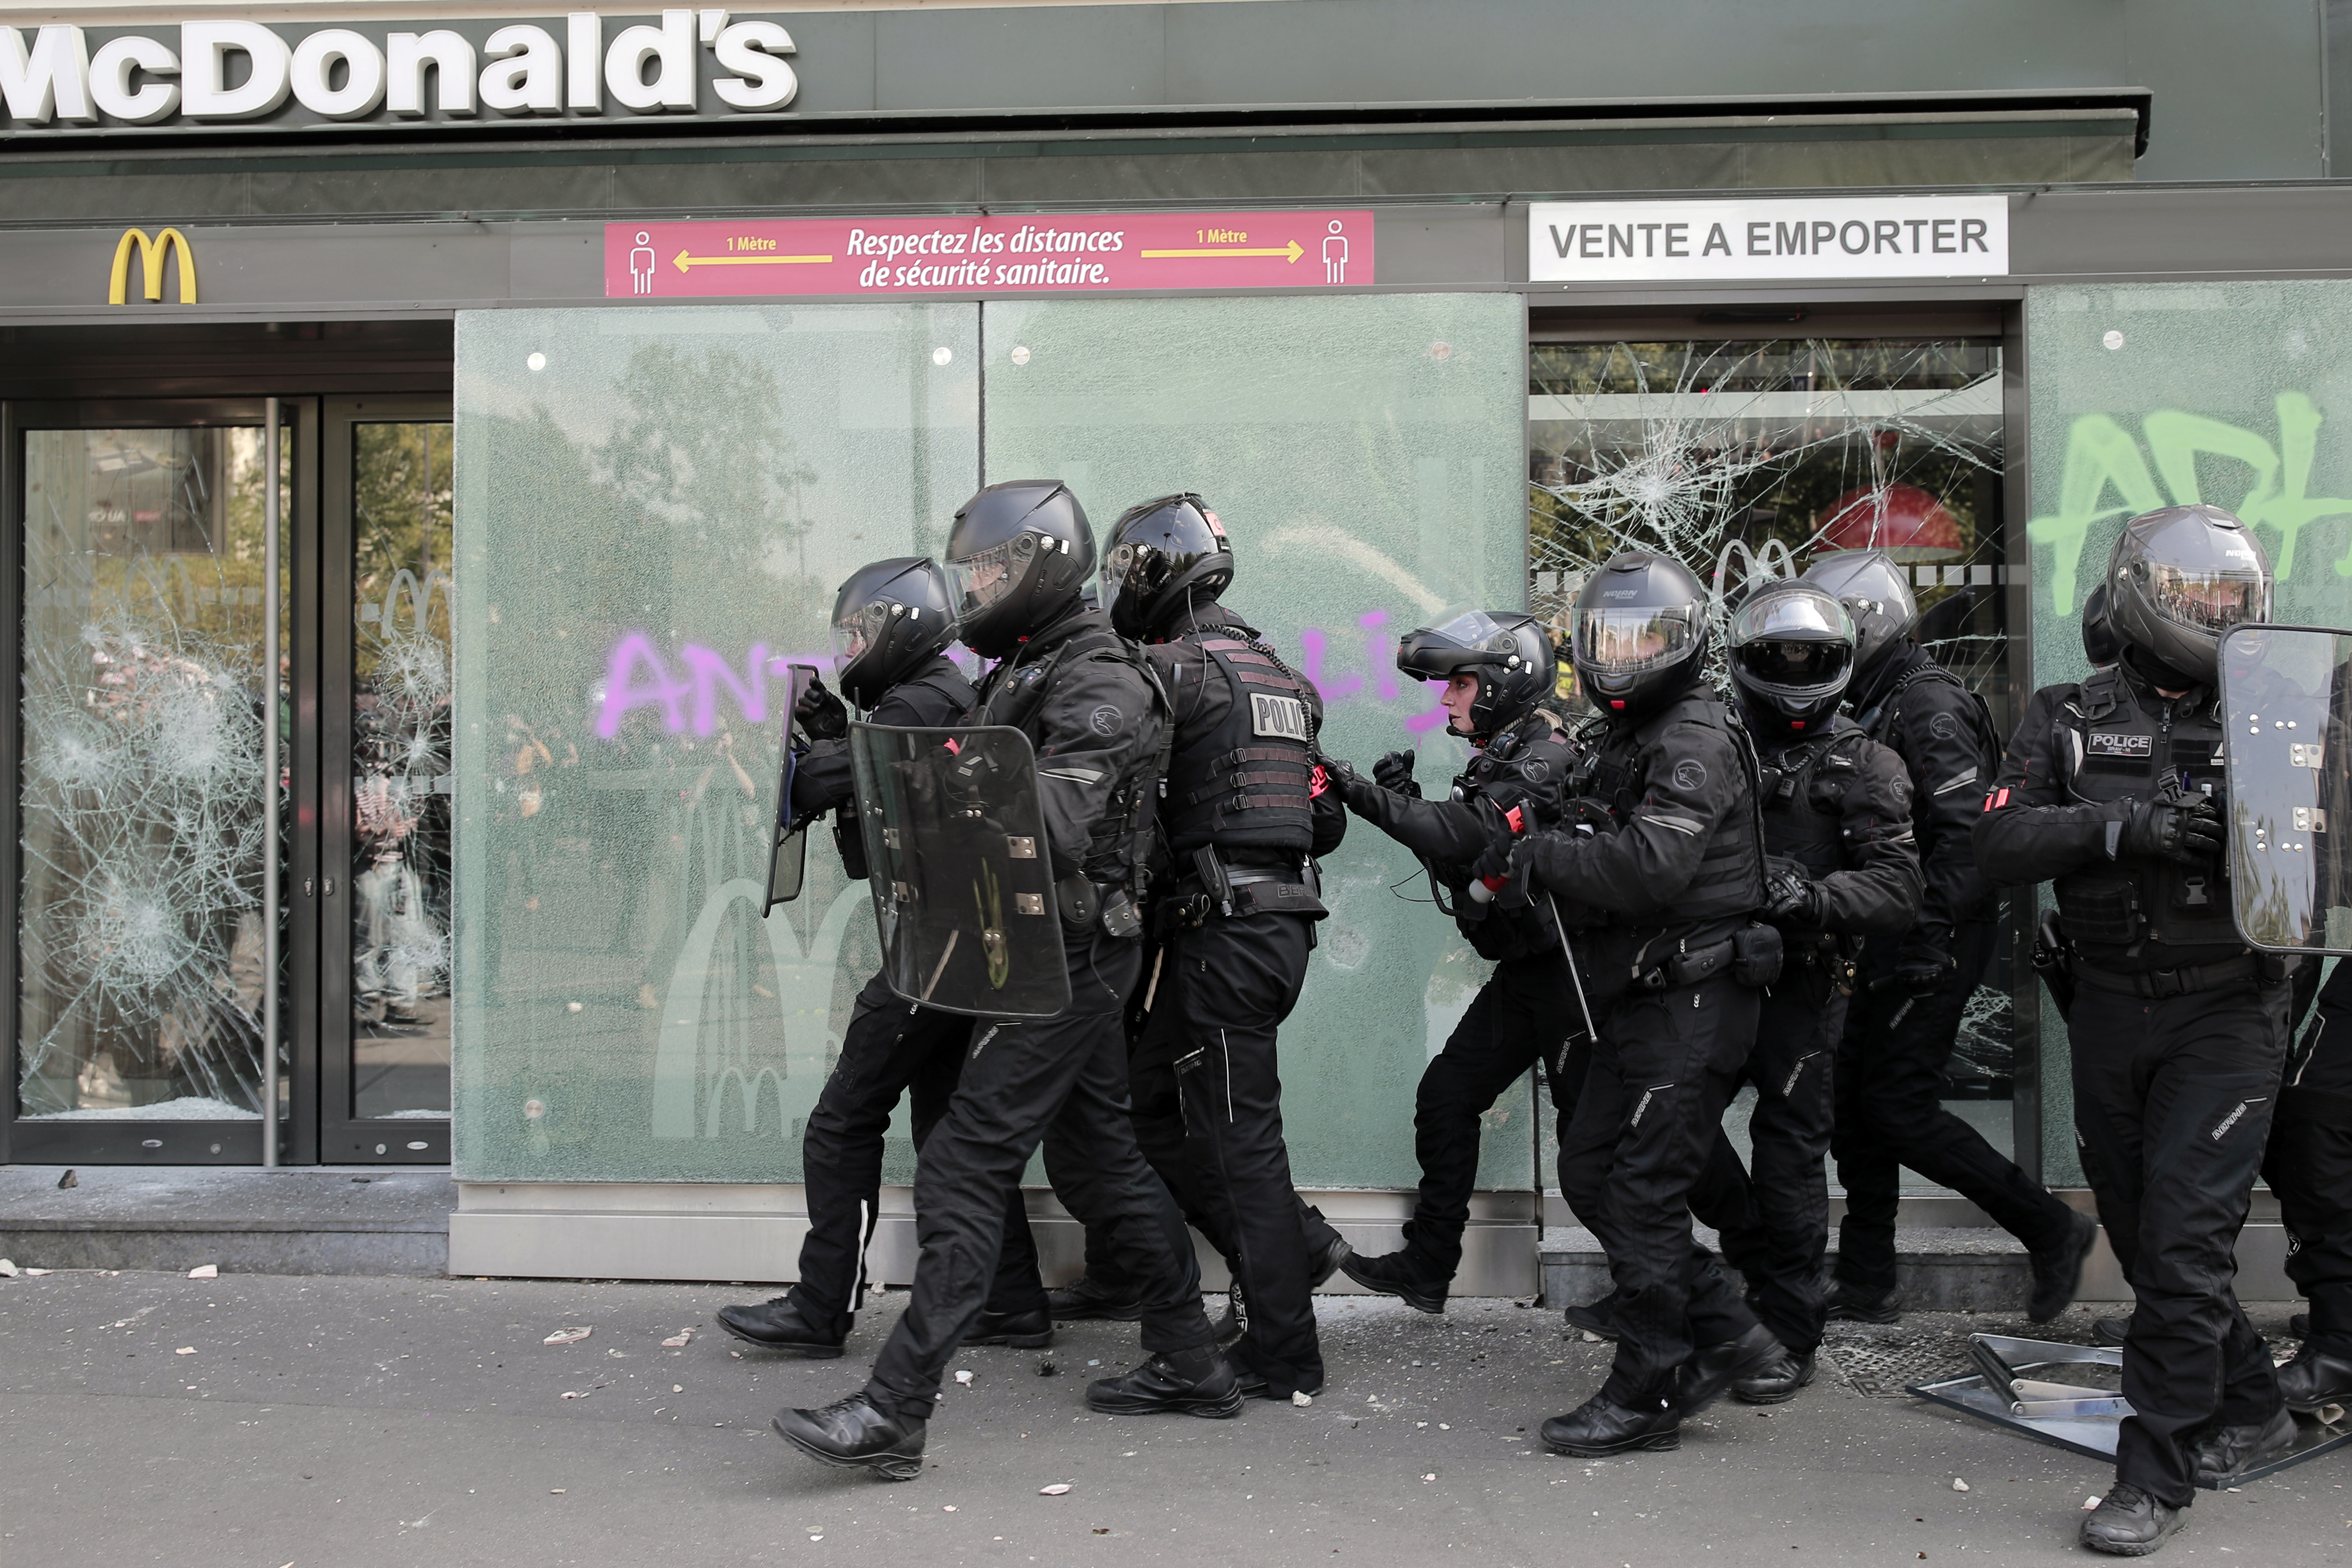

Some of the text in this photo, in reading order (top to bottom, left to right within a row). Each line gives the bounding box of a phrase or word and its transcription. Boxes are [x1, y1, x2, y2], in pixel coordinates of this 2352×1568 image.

[0, 8, 797, 123] McDonald's
[727, 236, 777, 251] 1 Mètre
[846, 224, 1124, 262] Respectez les distances
[1197, 228, 1248, 243] 1 Mètre
[1549, 218, 1989, 258] VENTE A EMPORTER
[859, 256, 1110, 287] de sécurité sanitaire.
[1256, 697, 1307, 737] POLIC
[2092, 735, 2149, 748] POLICE
[1556, 1041, 1571, 1074] BERING
[1783, 1061, 1804, 1097] BERING
[1631, 1091, 1652, 1127] BERING
